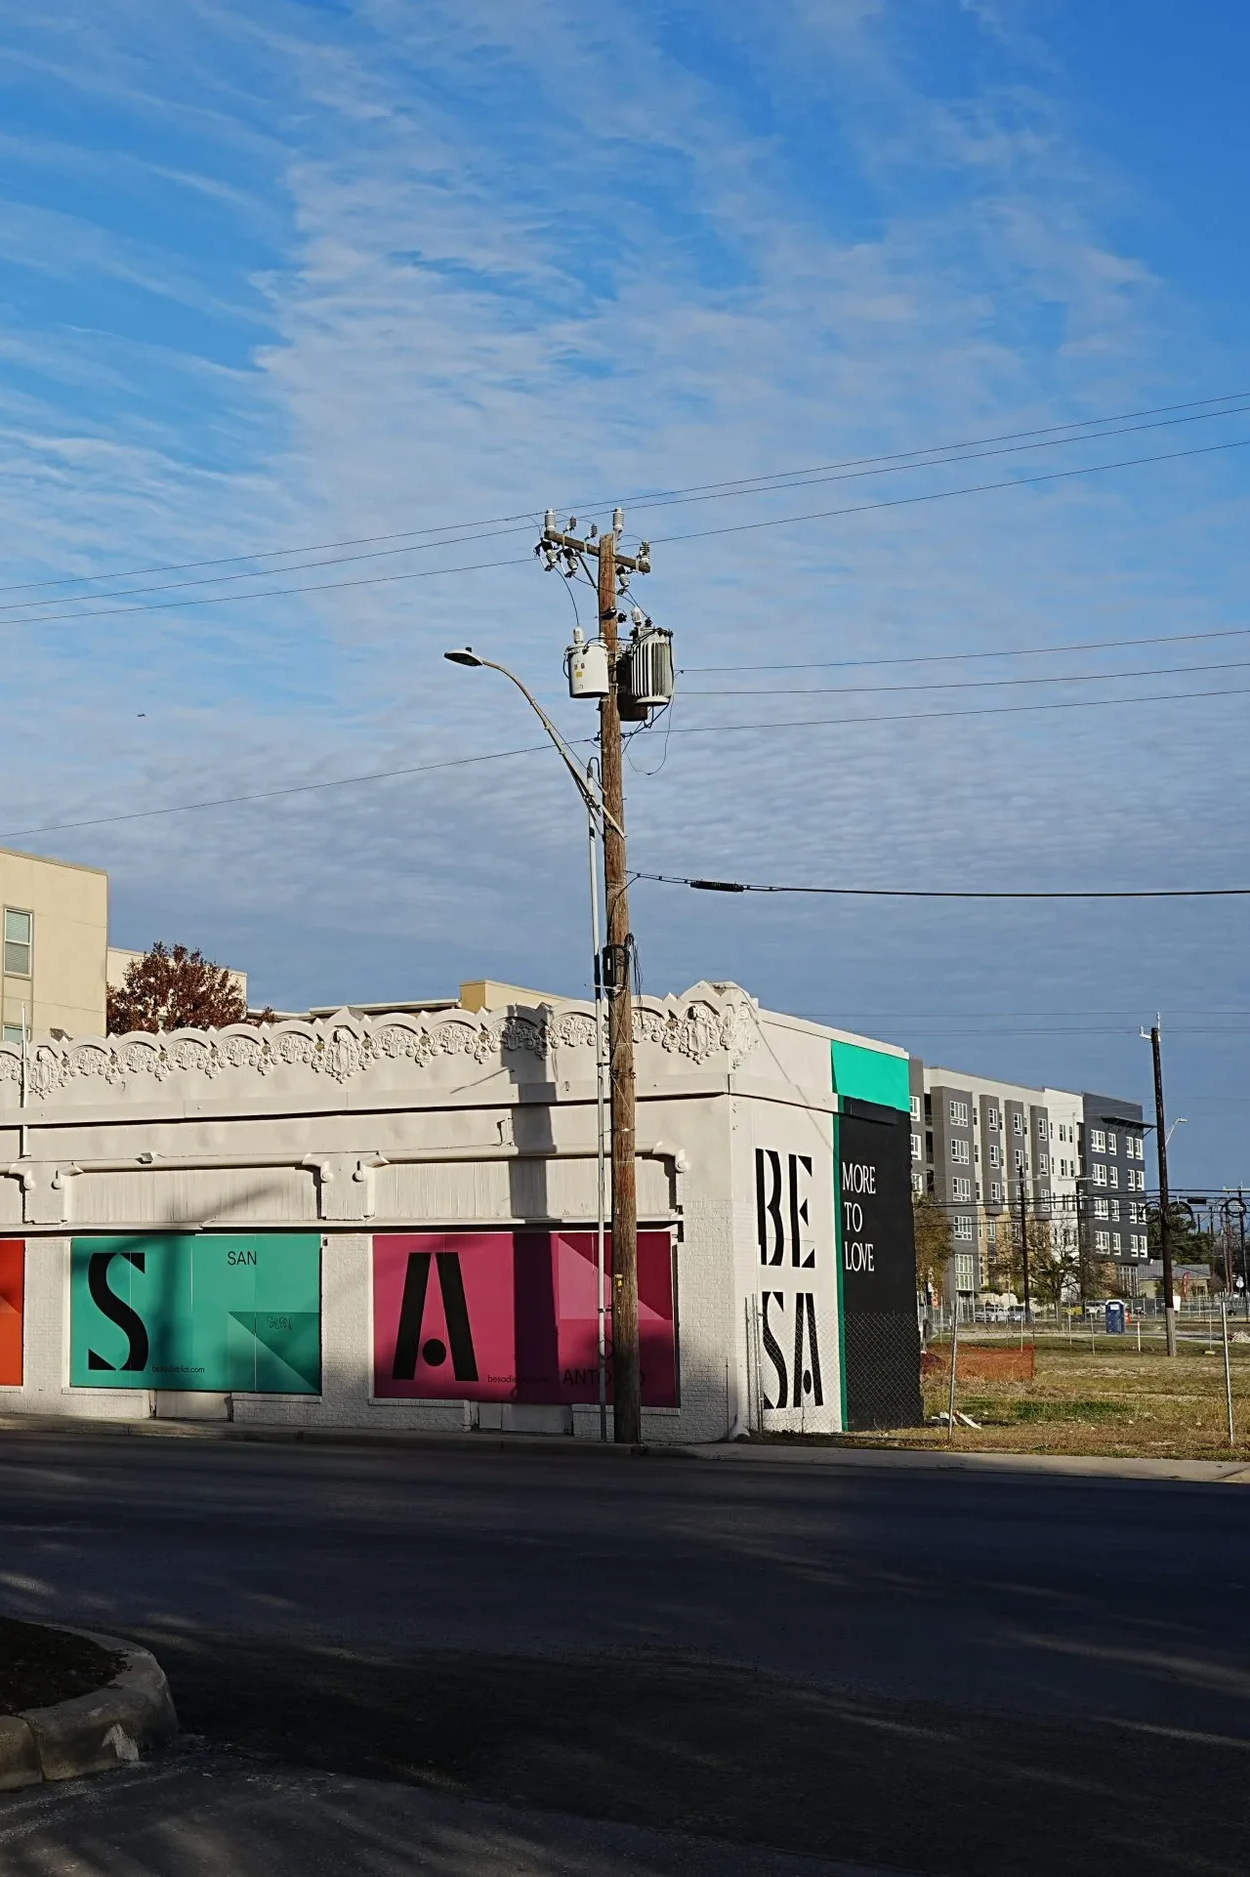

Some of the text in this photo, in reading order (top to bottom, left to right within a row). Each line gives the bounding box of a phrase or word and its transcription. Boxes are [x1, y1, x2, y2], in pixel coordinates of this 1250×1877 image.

[755, 1148, 815, 1268] BE
[842, 1161, 876, 1194] MORE
[844, 1202, 863, 1233] TO
[227, 1251, 257, 1266] SAN
[844, 1241, 875, 1272] LOVE
[88, 1252, 149, 1371] S
[392, 1252, 479, 1382] A
[762, 1291, 824, 1410] SA
